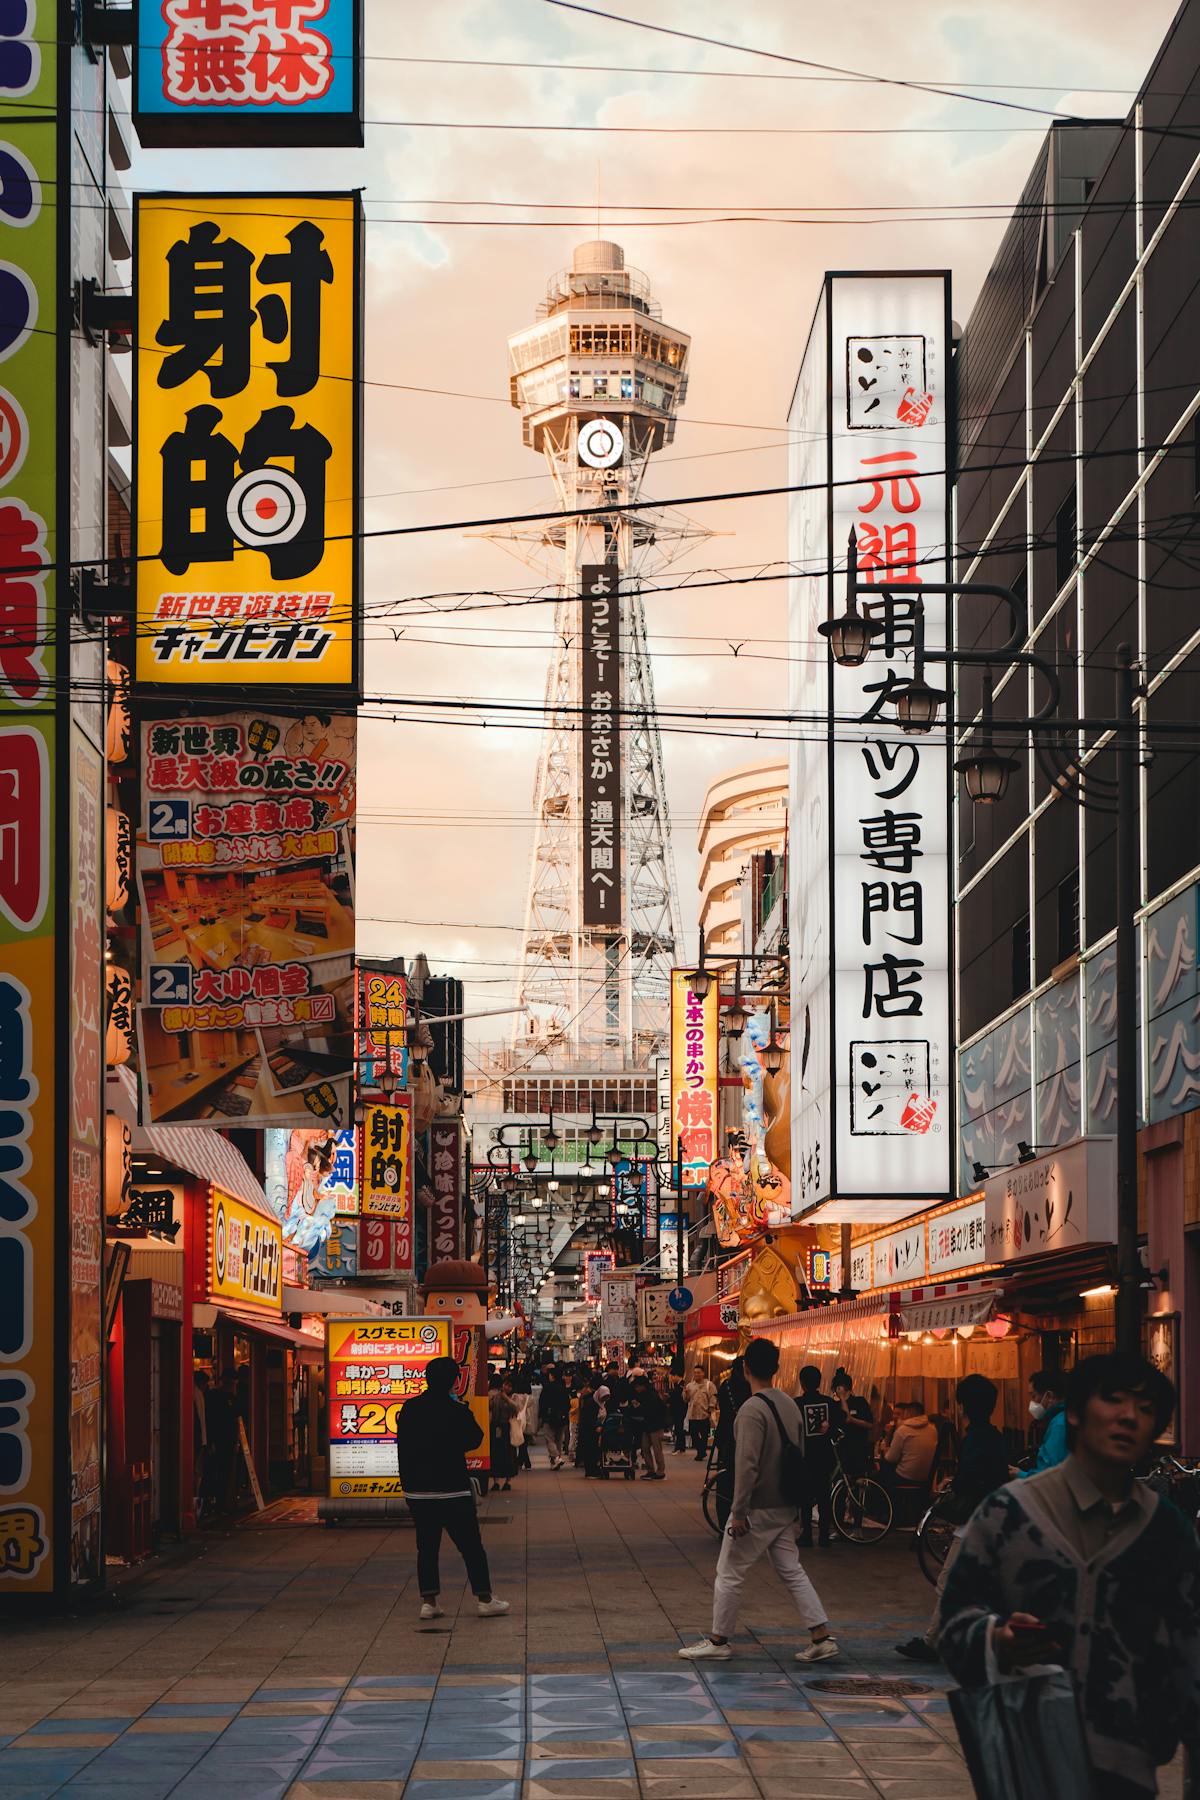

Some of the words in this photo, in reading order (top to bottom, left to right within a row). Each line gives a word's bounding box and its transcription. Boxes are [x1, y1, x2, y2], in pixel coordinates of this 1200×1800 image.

[178, 33, 317, 95] 無休
[156, 221, 333, 580] 射的
[157, 595, 332, 619] 新世界遊技場
[152, 726, 241, 756] 新世界
[195, 965, 308, 1000] 大小個室
[370, 978, 403, 1006] 24
[370, 1109, 404, 1193] 射的
[357, 1327, 416, 1340] スグそこ!
